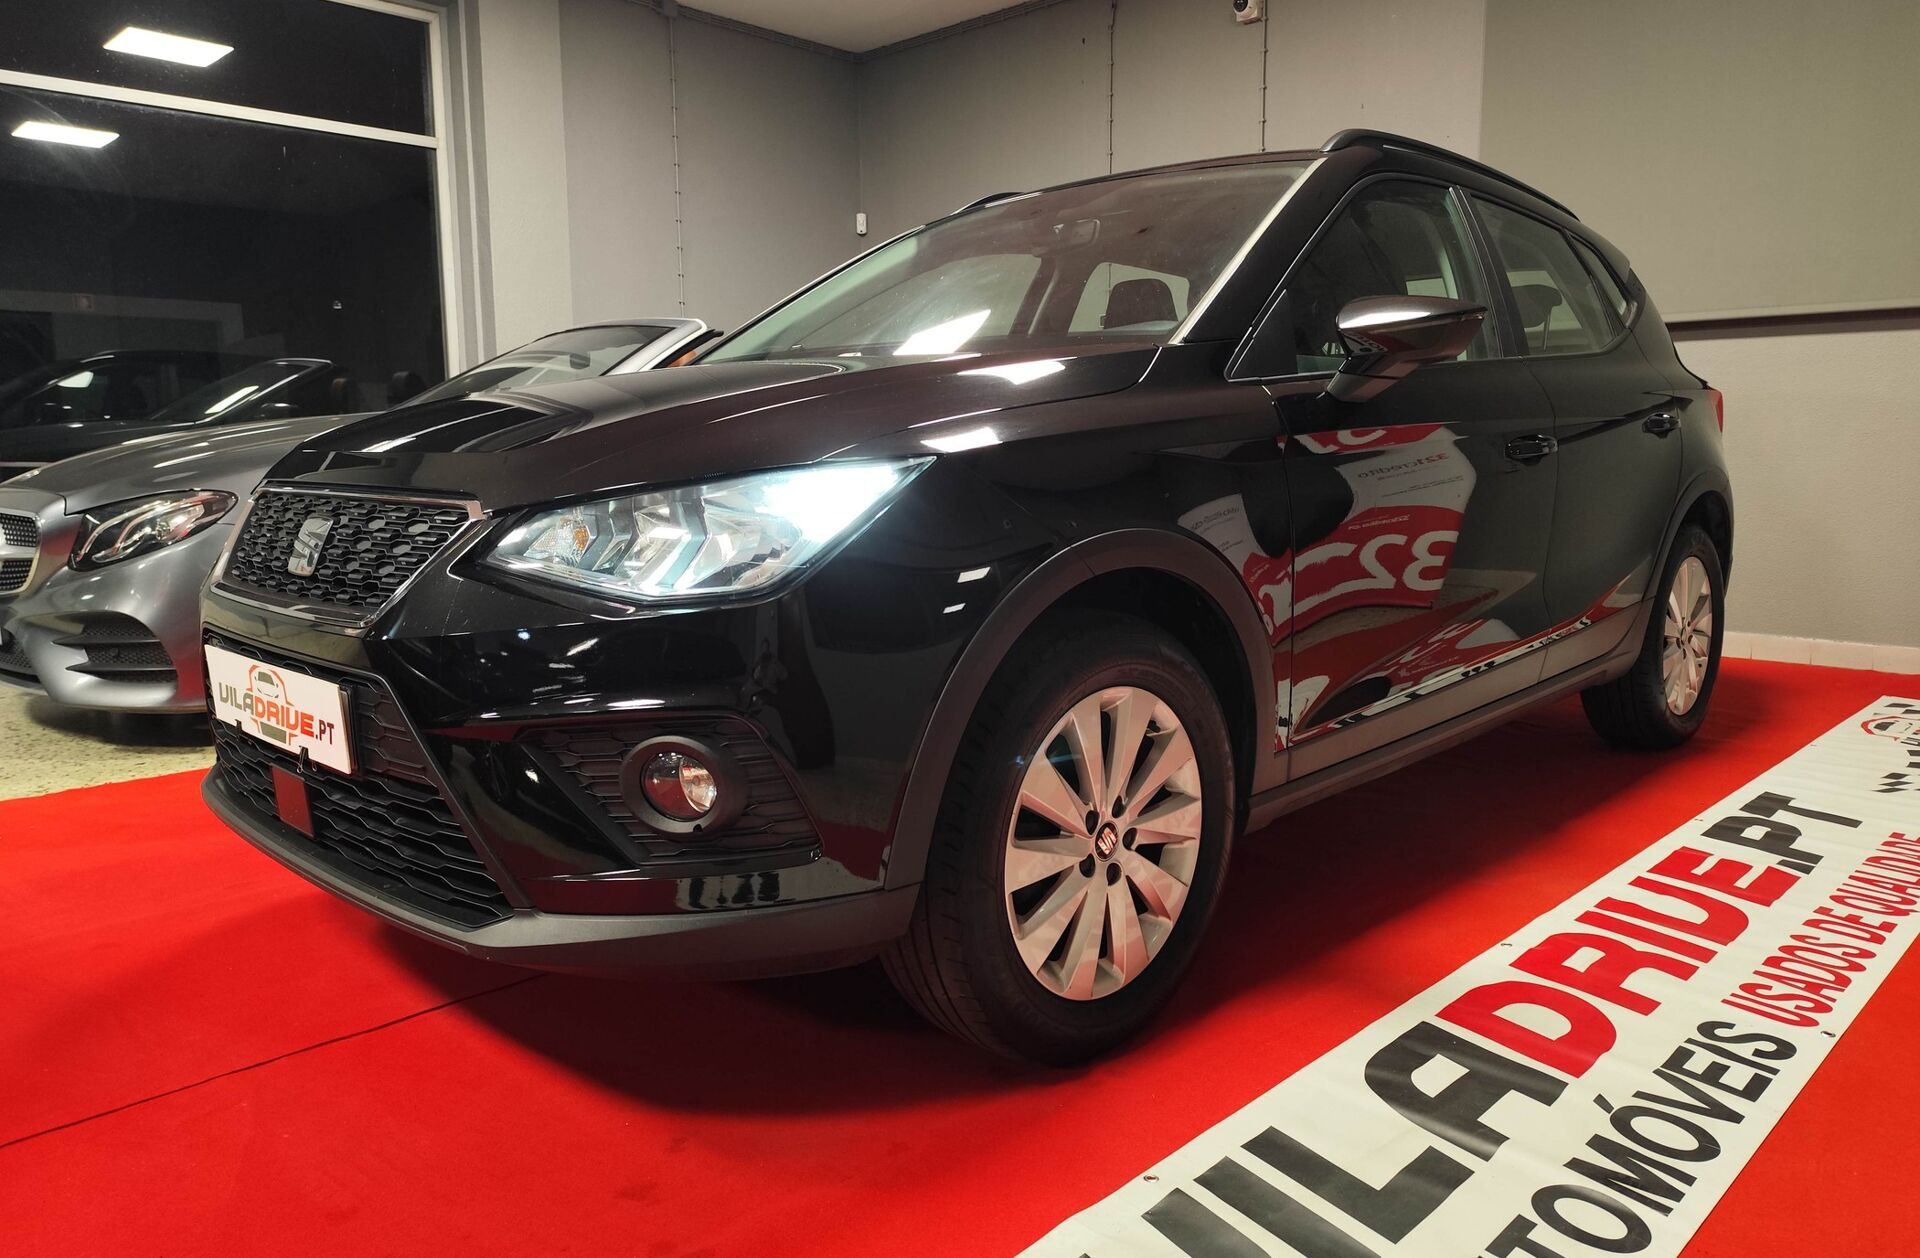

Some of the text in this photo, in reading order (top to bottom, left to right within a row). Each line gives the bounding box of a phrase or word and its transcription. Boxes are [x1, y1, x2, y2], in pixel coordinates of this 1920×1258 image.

[219, 682, 334, 745] VILADRIVE.PT
[1476, 1021, 1797, 1258] TOMÓVEIS
[1720, 935, 1877, 1027] USADOS
[1801, 906, 1898, 945] DE
